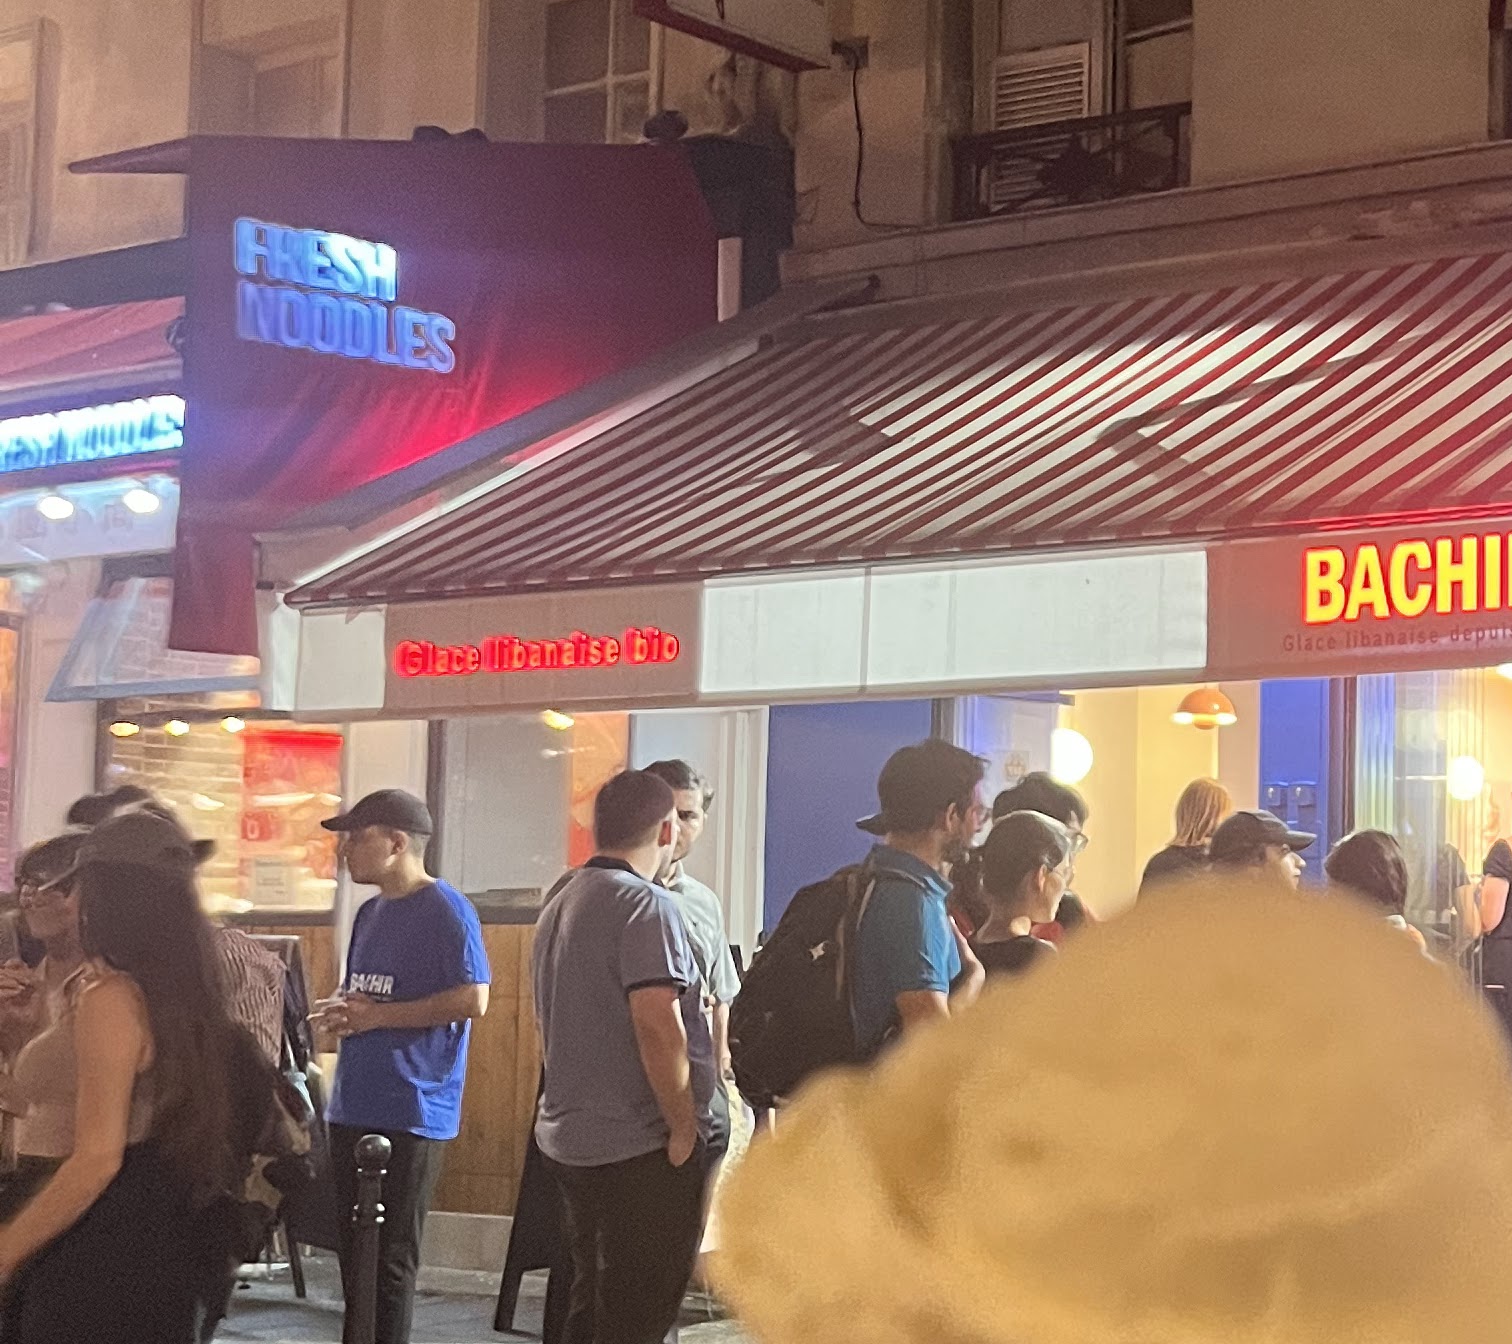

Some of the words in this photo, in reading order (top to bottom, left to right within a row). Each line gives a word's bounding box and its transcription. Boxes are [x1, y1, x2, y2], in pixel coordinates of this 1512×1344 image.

[234, 217, 398, 301] FRESH
[237, 281, 456, 373] NOODLES
[396, 640, 480, 676] Glace
[482, 631, 620, 672] libanaise
[624, 627, 679, 664] bio
[1282, 633, 1337, 652] Glace
[1345, 626, 1439, 649] libanaise
